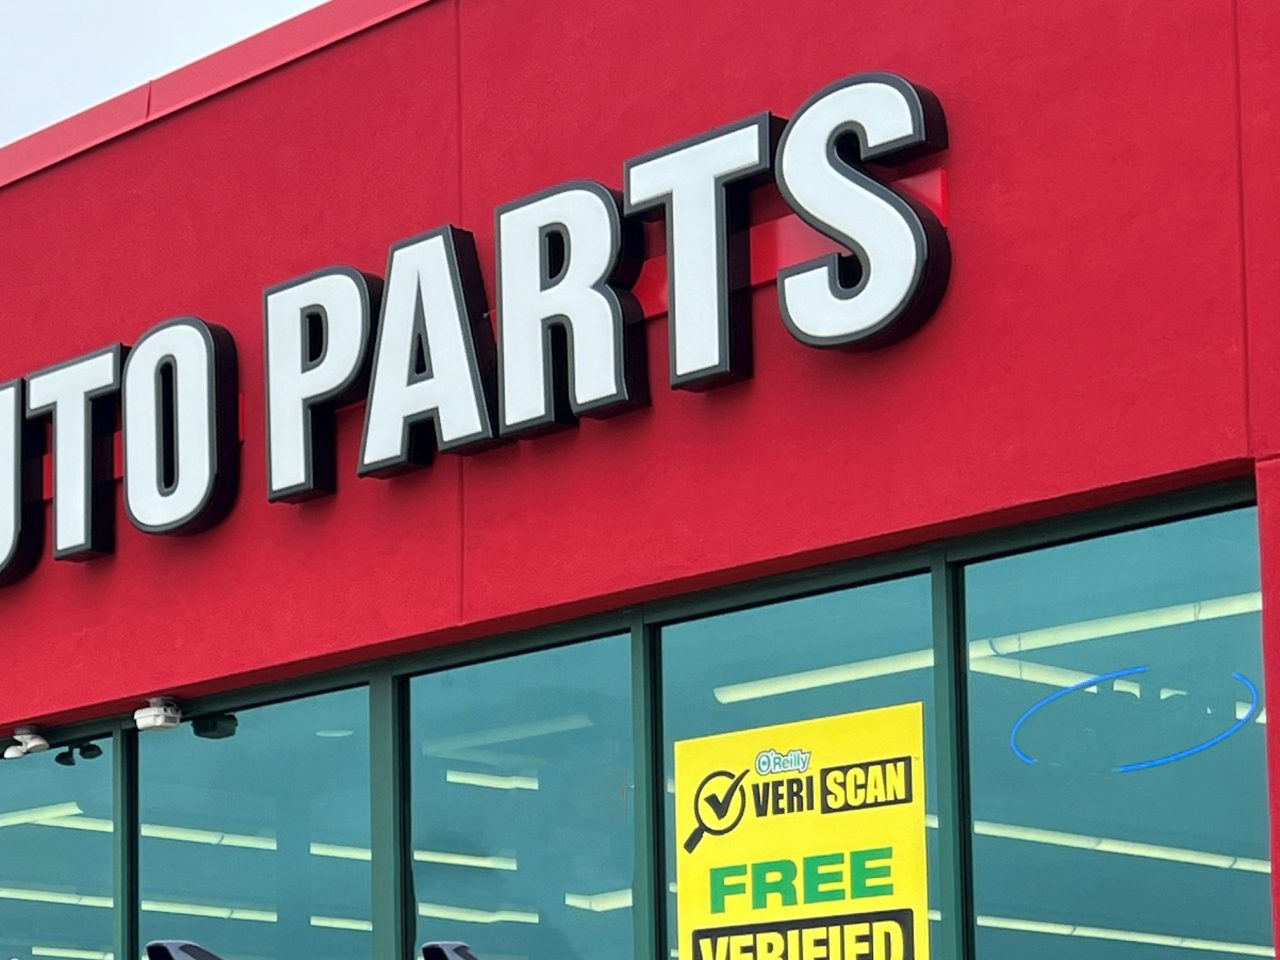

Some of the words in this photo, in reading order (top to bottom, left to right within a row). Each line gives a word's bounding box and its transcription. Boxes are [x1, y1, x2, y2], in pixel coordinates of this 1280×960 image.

[263, 71, 944, 504] PARTS
[752, 776, 814, 817] VERI
[825, 762, 906, 809] SCAN
[756, 751, 811, 776] O'Reilly
[710, 846, 894, 914] FREE
